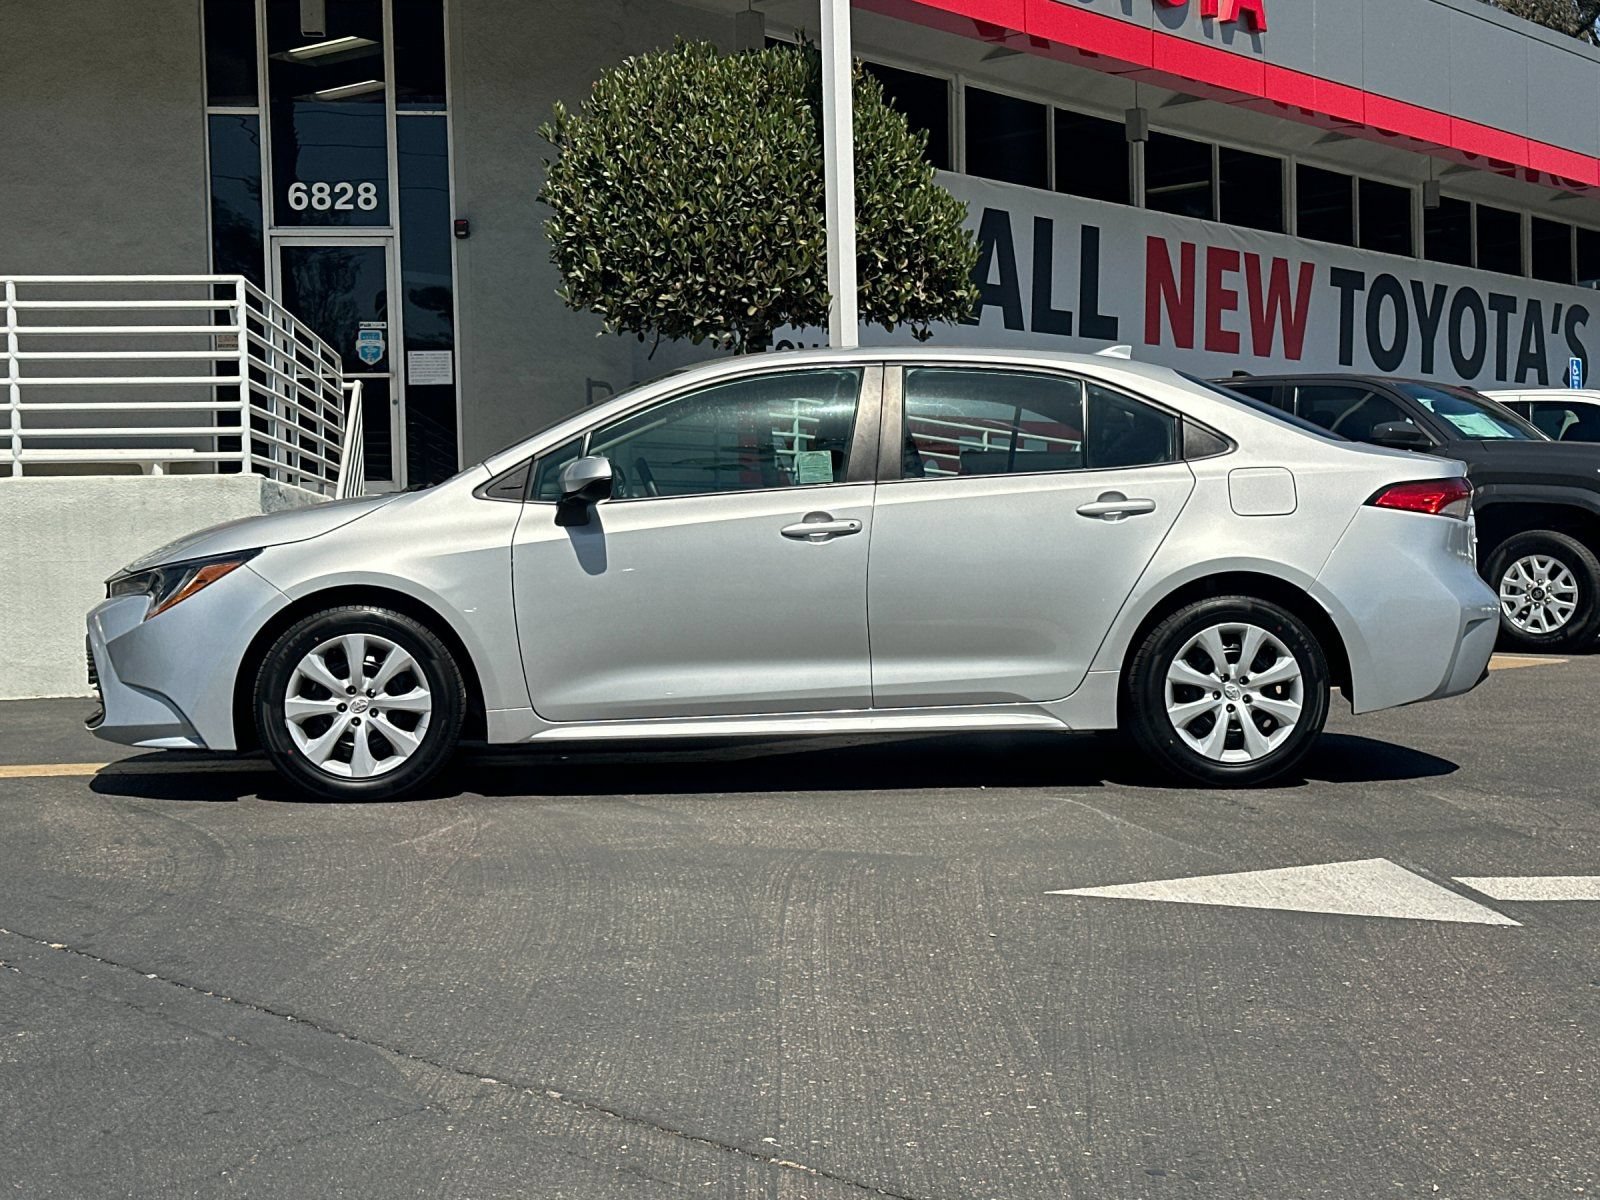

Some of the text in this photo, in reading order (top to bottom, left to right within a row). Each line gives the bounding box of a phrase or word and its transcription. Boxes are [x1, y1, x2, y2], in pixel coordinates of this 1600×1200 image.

[288, 182, 377, 211] 6828
[958, 207, 1590, 388] ALL NEW TOYOTA'S
